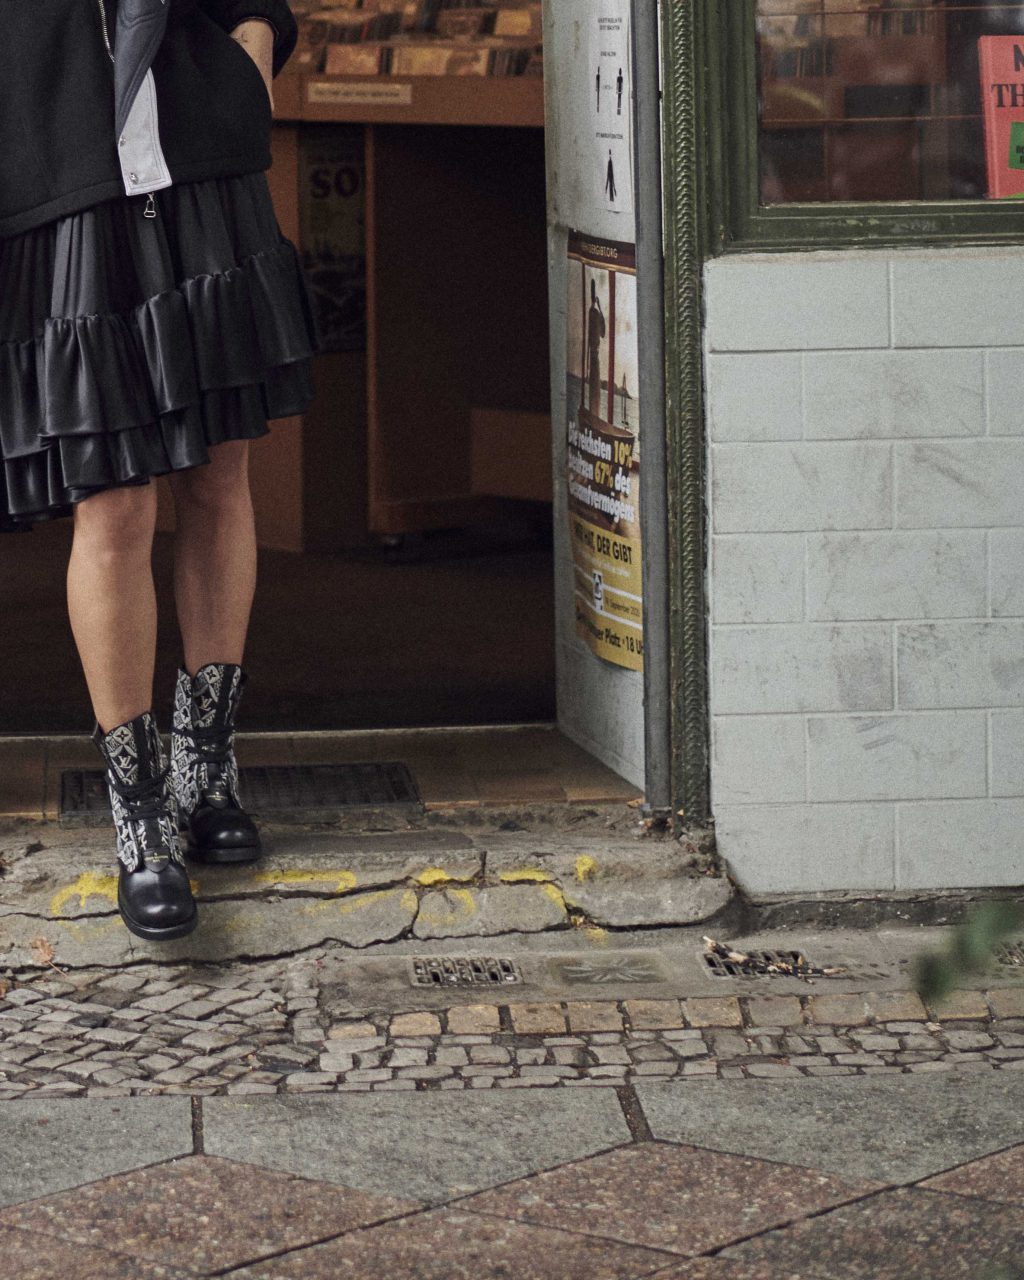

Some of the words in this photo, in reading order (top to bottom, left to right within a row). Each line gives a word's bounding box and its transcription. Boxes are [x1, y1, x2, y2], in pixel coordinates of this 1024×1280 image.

[614, 440, 633, 469] 10%
[594, 461, 614, 489] 67%
[615, 466, 631, 497] des
[596, 534, 611, 557] DER
[613, 541, 633, 565] GIBT
[625, 635, 635, 652] 18
